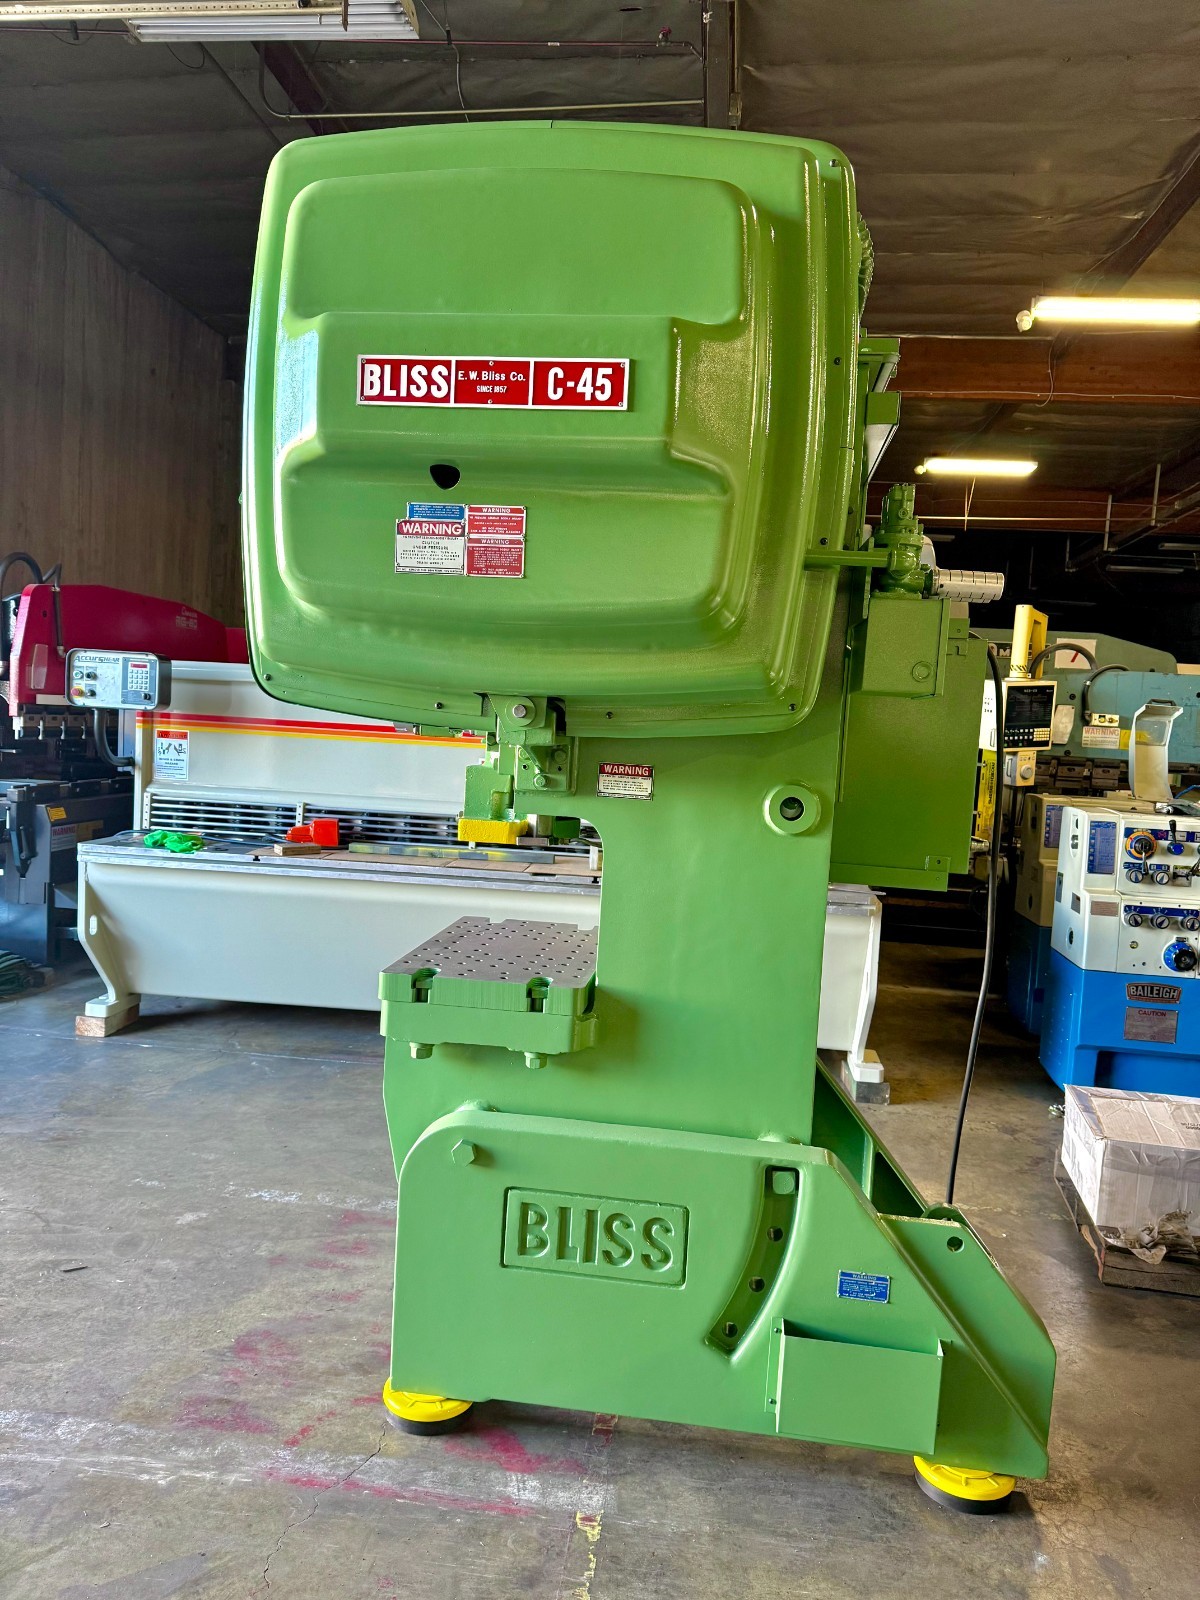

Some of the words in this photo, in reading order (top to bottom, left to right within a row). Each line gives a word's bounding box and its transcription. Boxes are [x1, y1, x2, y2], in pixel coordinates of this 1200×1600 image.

[364, 364, 449, 398] BLISS
[458, 371, 467, 380] E.
[469, 371, 480, 380] W.
[482, 371, 506, 381] Bliss
[510, 372, 526, 382] Co.
[476, 385, 492, 393] SINCE
[548, 366, 612, 402] C-45
[402, 522, 462, 535] WARNING
[1084, 728, 1120, 736] WARNING
[604, 764, 648, 776] WARNING
[1130, 986, 1178, 998] BAILEIGH
[517, 1202, 675, 1272] BLISS
